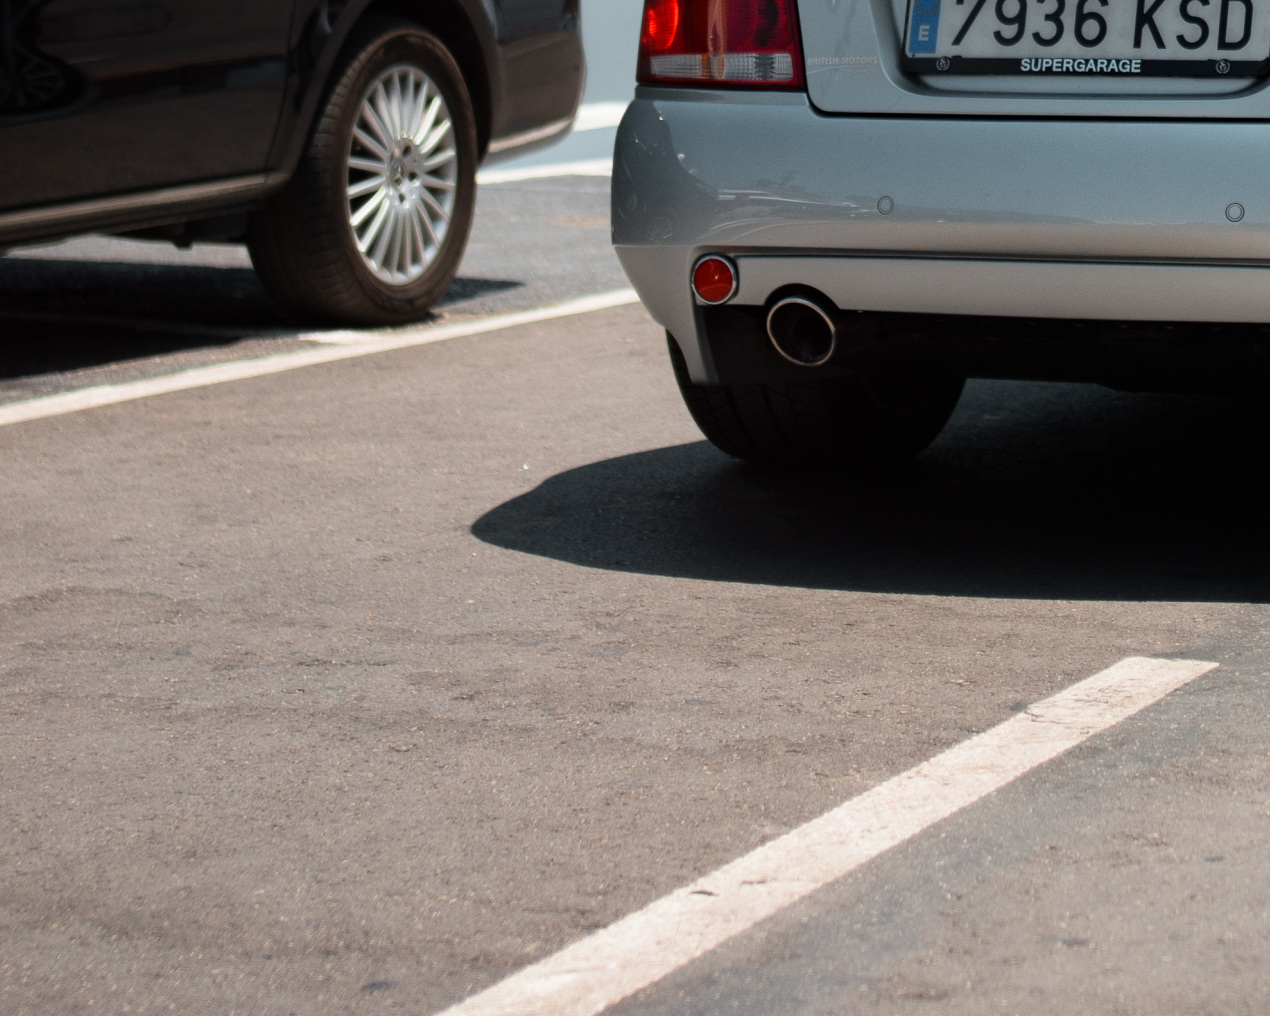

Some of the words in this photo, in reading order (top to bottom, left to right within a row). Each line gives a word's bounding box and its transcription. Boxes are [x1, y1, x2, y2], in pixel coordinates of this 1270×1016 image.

[918, 25, 930, 42] E
[807, 57, 839, 65] BRITISH
[841, 56, 878, 65] MOTORS
[1020, 58, 1142, 73] SUPERGARAGE
